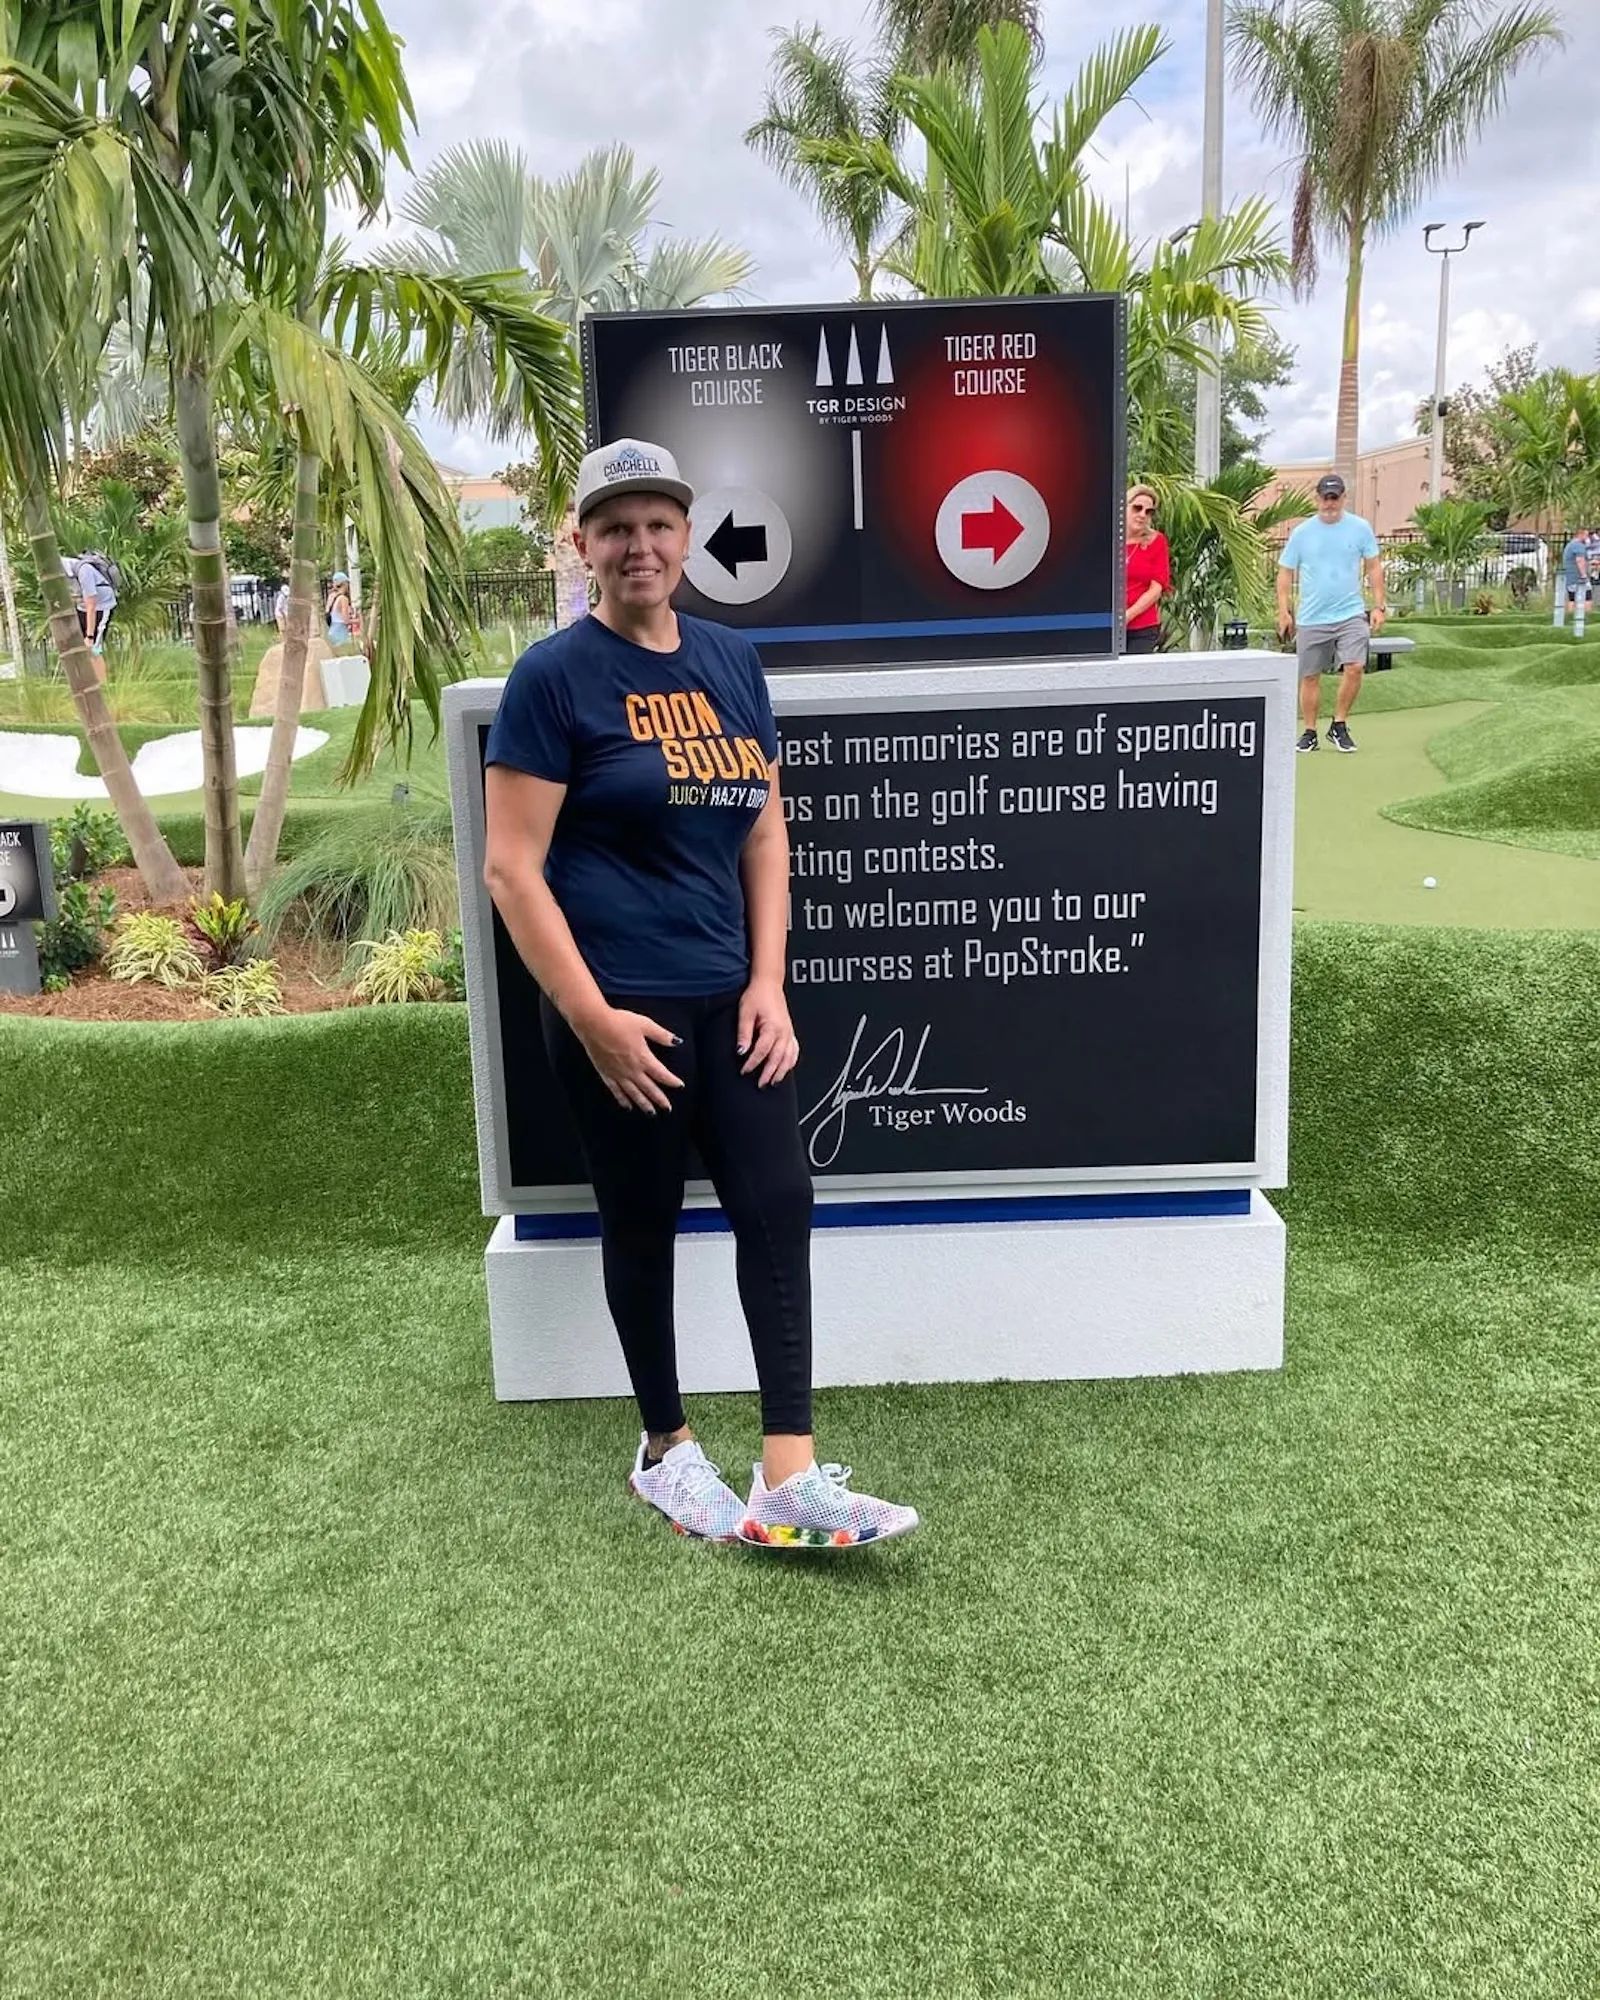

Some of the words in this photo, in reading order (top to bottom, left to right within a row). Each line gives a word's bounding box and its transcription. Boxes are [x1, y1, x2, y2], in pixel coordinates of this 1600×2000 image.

[668, 345, 719, 372] TIGER
[726, 343, 784, 371] BLACK
[944, 335, 995, 361] TIGER
[1002, 333, 1036, 359] RED
[691, 378, 763, 406] COURSE
[955, 368, 1026, 396] COURSE
[806, 400, 839, 413] TGR
[845, 396, 906, 412] DESIGN
[832, 415, 858, 424] TIGER
[860, 414, 893, 423] WOODS
[604, 458, 662, 477] COACHELLA
[626, 692, 723, 740] GOON
[845, 725, 999, 763] memories
[1013, 730, 1063, 757] are
[1077, 713, 1107, 754] of
[1117, 709, 1255, 761] spending
[667, 785, 708, 805] JUICY
[709, 786, 747, 807] HAZY
[825, 794, 859, 820] on
[871, 779, 919, 818] the
[932, 775, 989, 825] golf
[1000, 785, 1105, 814] course
[1119, 769, 1217, 814] having
[865, 838, 1003, 873] contests.
[804, 899, 833, 929] to
[844, 888, 976, 928] welcome
[989, 897, 1040, 932] you
[1051, 889, 1081, 920] to
[1094, 893, 1145, 919] our
[792, 955, 912, 983] courses
[925, 947, 953, 978] at
[869, 1106, 935, 1131] Tiger
[941, 1100, 1026, 1123] Woods
